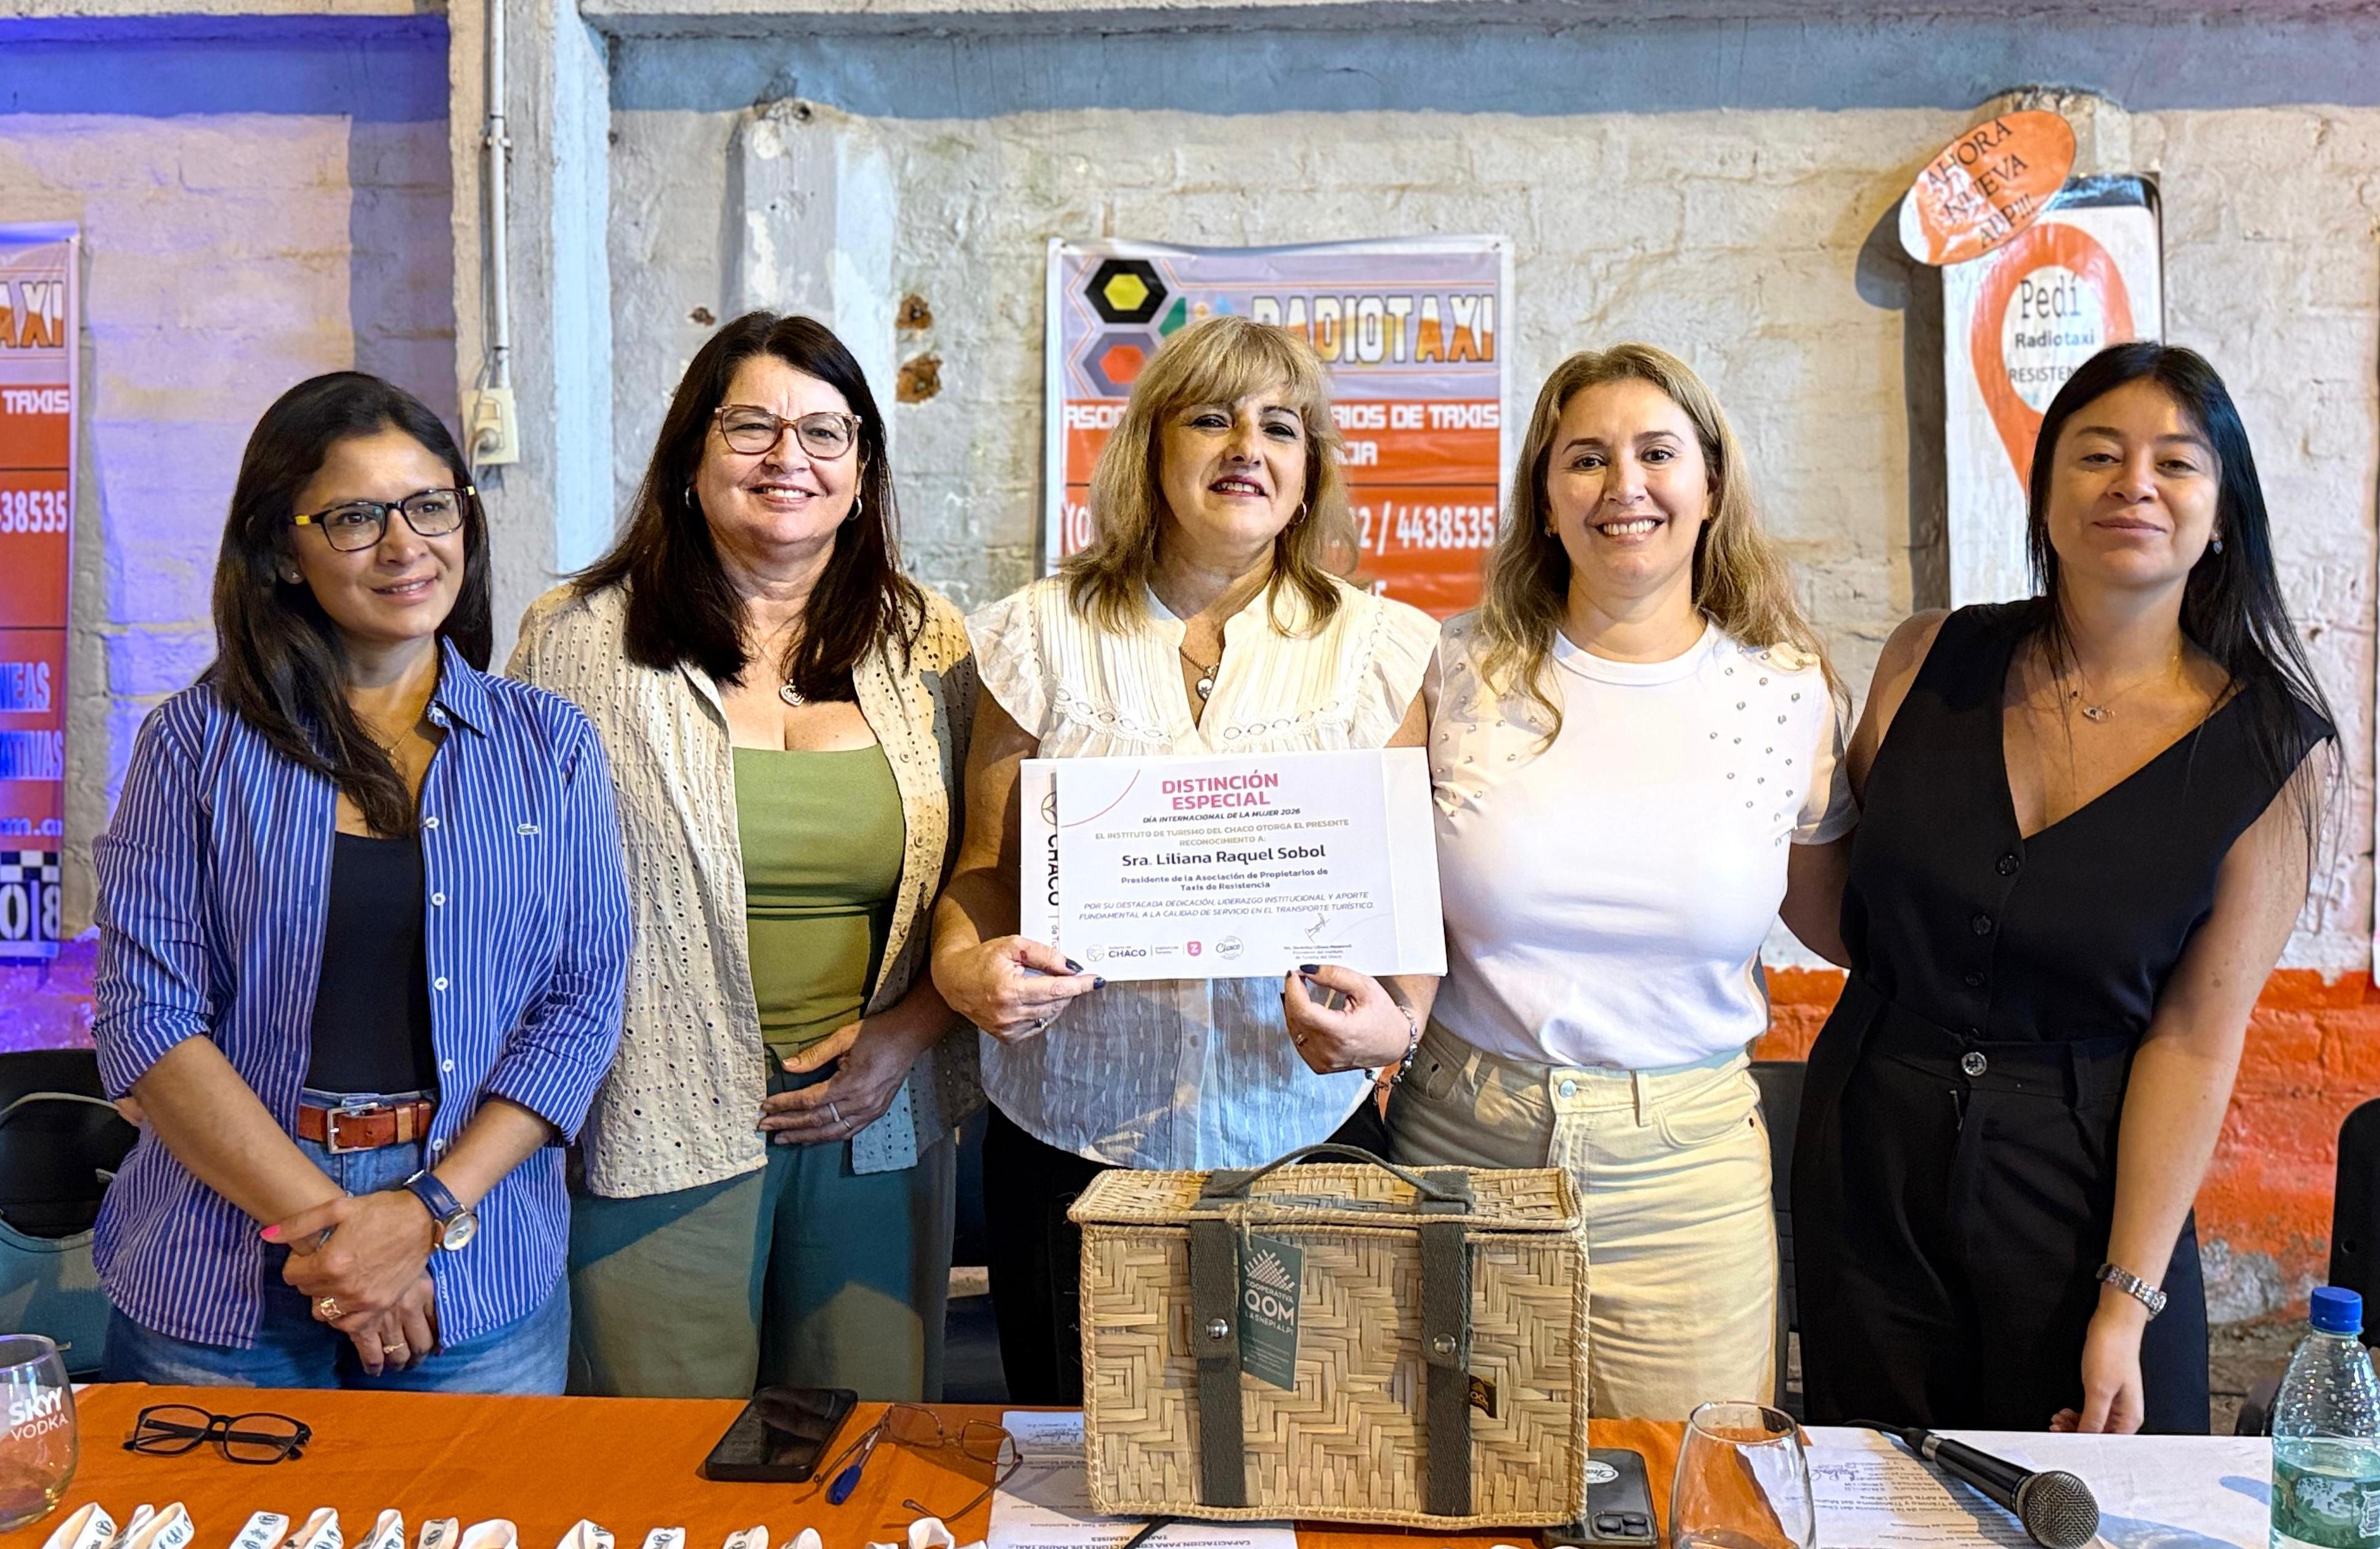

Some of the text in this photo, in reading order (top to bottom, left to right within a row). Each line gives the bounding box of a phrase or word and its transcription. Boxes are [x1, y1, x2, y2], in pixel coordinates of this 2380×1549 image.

[1927, 120, 2012, 191] AHORA
[1944, 153, 2028, 222] NUEVA
[2020, 272, 2081, 319] Pedí
[2015, 329, 2095, 349] Radiotaxi
[2, 389, 70, 414] TAXIS
[1391, 404, 1424, 429] DE
[1428, 404, 1500, 429] TAXIS
[1396, 506, 1495, 549] 4438535
[1162, 770, 1278, 794] DISTINCIÓN
[1172, 791, 1271, 810] ESPECIAL
[1159, 813, 1224, 823] INTERNACIONAL
[1108, 831, 1151, 839] INSTITUTO
[1166, 829, 1205, 837] TURISMO
[1256, 823, 1292, 831] OTORGA
[1306, 819, 1349, 828] PRESENTE
[1179, 836, 1256, 847] RECONOCIMIENTO
[1122, 845, 1326, 866] Sra. Liliana Raquel Sobol
[1121, 876, 1169, 884] Presidente
[1195, 871, 1245, 881] Asociación
[1219, 882, 1270, 890] Resistencia
[1116, 900, 1163, 908] DESTACADA
[1217, 896, 1263, 905] LIDERAZGO
[1265, 895, 1325, 903] INSTITUCIONAL
[1079, 911, 1140, 920] FUNDAMENTAL
[1213, 908, 1249, 916] SERVICIO
[1276, 905, 1329, 913] TRANSPORTE
[1108, 949, 1147, 958] CHACO
[1245, 1289, 1294, 1326] QOM
[9, 1386, 62, 1425] SKYY
[10, 1413, 69, 1441] VODKA
